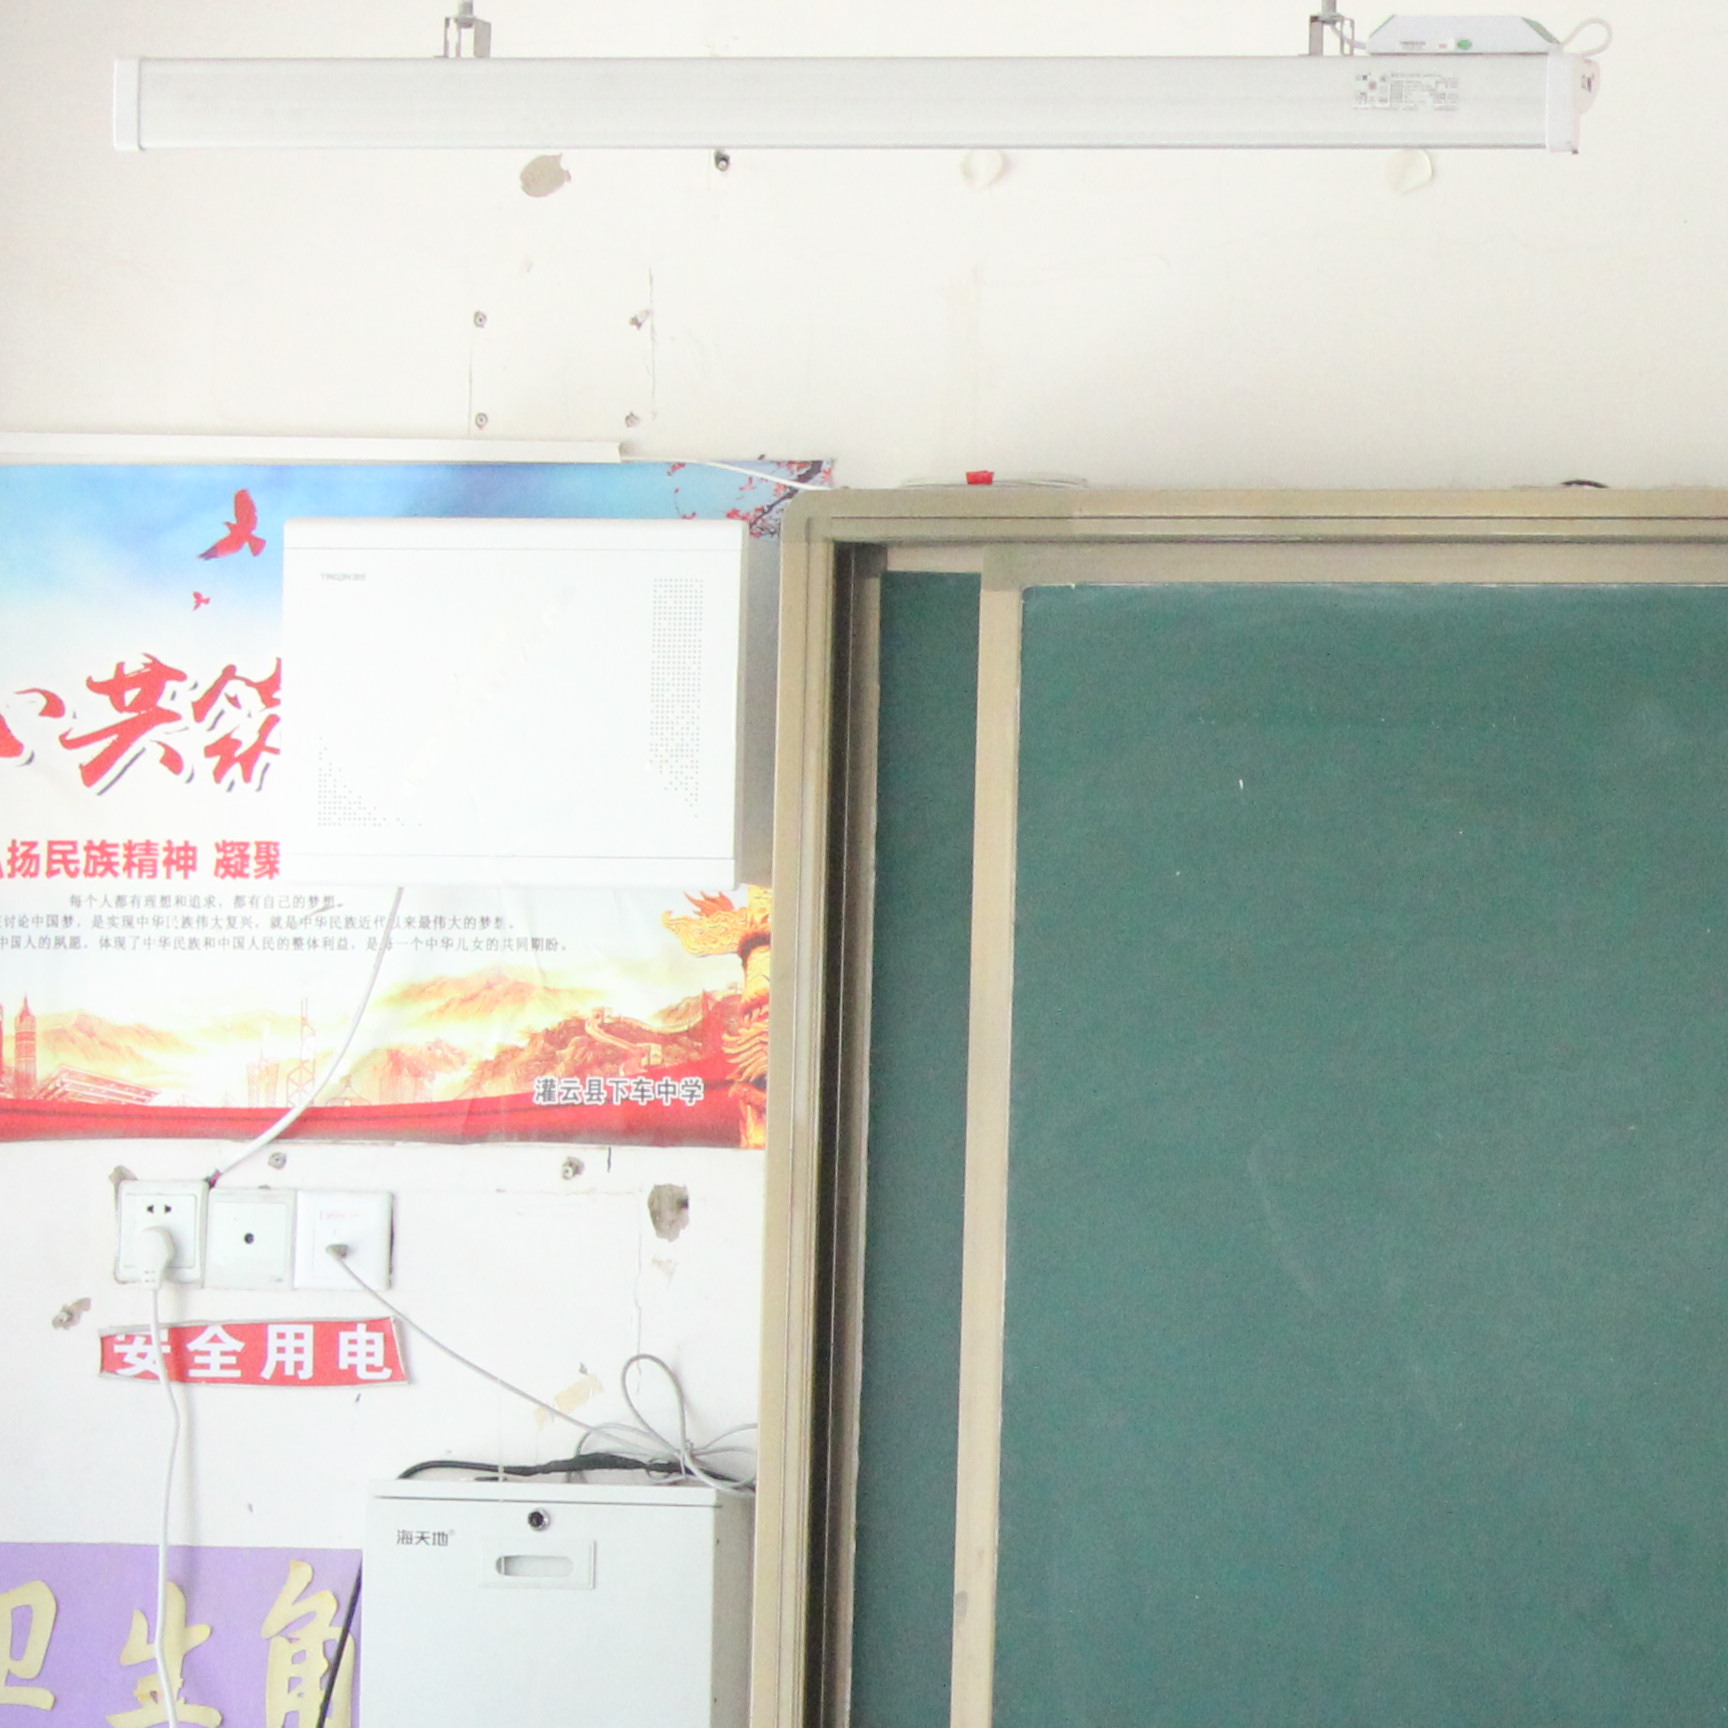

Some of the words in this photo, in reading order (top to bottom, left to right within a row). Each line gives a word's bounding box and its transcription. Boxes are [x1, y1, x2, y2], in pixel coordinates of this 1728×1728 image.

[0, 839, 198, 879] 扬民族精神
[535, 1077, 705, 1107] 灌云县下车中学
[113, 1323, 393, 1381] 安全用电
[396, 1529, 449, 1546] 海天地
